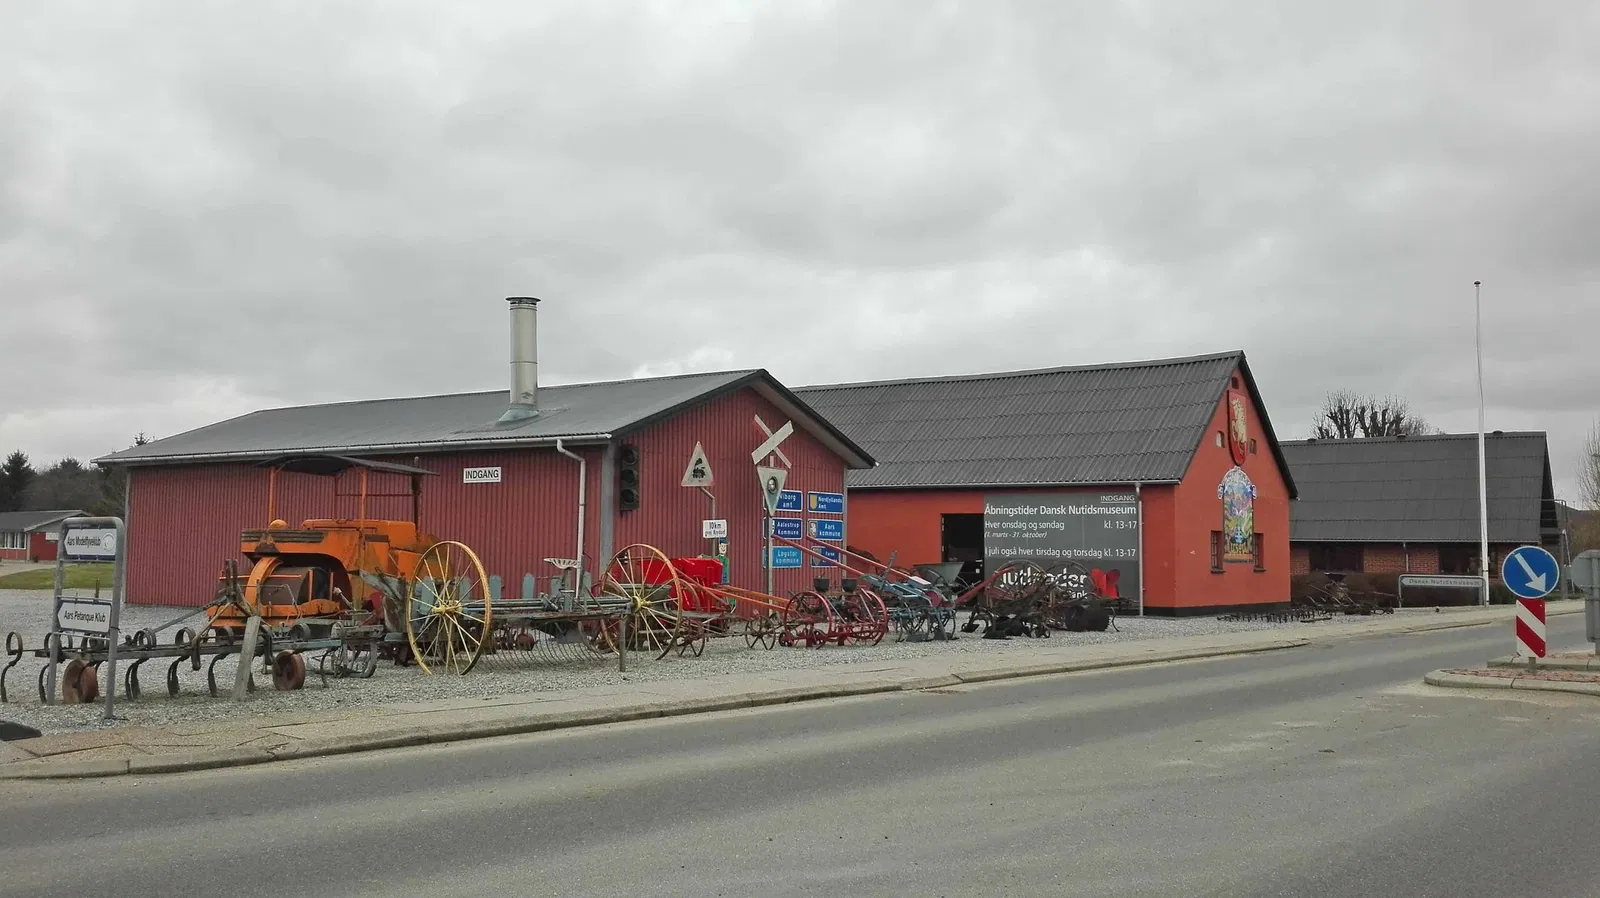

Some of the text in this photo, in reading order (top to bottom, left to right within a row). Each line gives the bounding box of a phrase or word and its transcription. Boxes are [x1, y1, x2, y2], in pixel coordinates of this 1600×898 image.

[465, 470, 499, 479] INDGANG
[984, 503, 1136, 517] Åbningstider Dansk Nutidsmuseum
[1002, 520, 1026, 530] onsdag
[1028, 522, 1037, 530] og
[1039, 520, 1064, 530] søndag
[1104, 520, 1137, 529] kl. 13-17
[988, 547, 999, 556] juli
[1001, 546, 1017, 557] også
[1019, 547, 1033, 555] hver
[1036, 548, 1060, 558] tirsdag
[1062, 549, 1072, 558] og
[1073, 548, 1102, 558] torsdag
[1104, 548, 1113, 556] kl.
[1115, 548, 1136, 557] 13-17
[64, 610, 106, 623] Aars Petanque Klub
